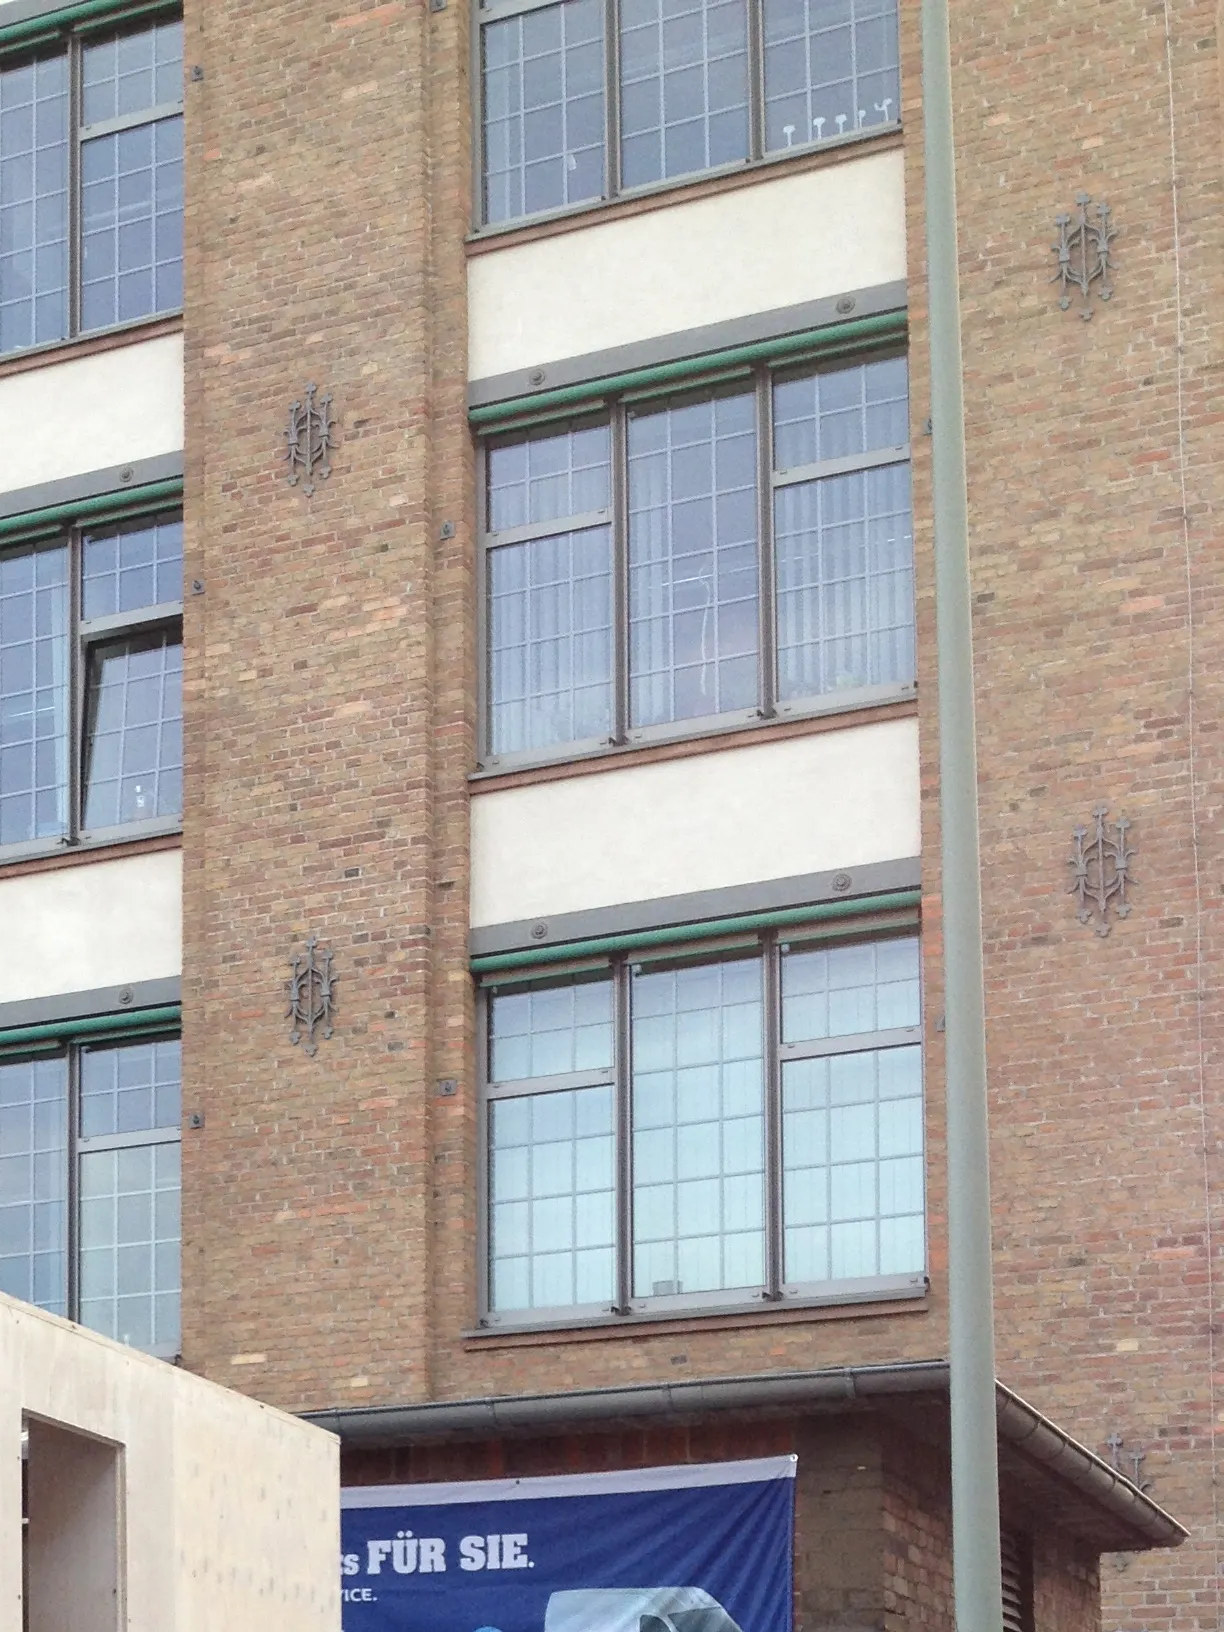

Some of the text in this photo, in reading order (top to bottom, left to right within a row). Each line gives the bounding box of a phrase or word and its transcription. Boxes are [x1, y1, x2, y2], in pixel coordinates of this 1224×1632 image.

[367, 1530, 446, 1575] FÜR
[459, 1533, 535, 1571] SIE.
[341, 1588, 378, 1602] ICE.
